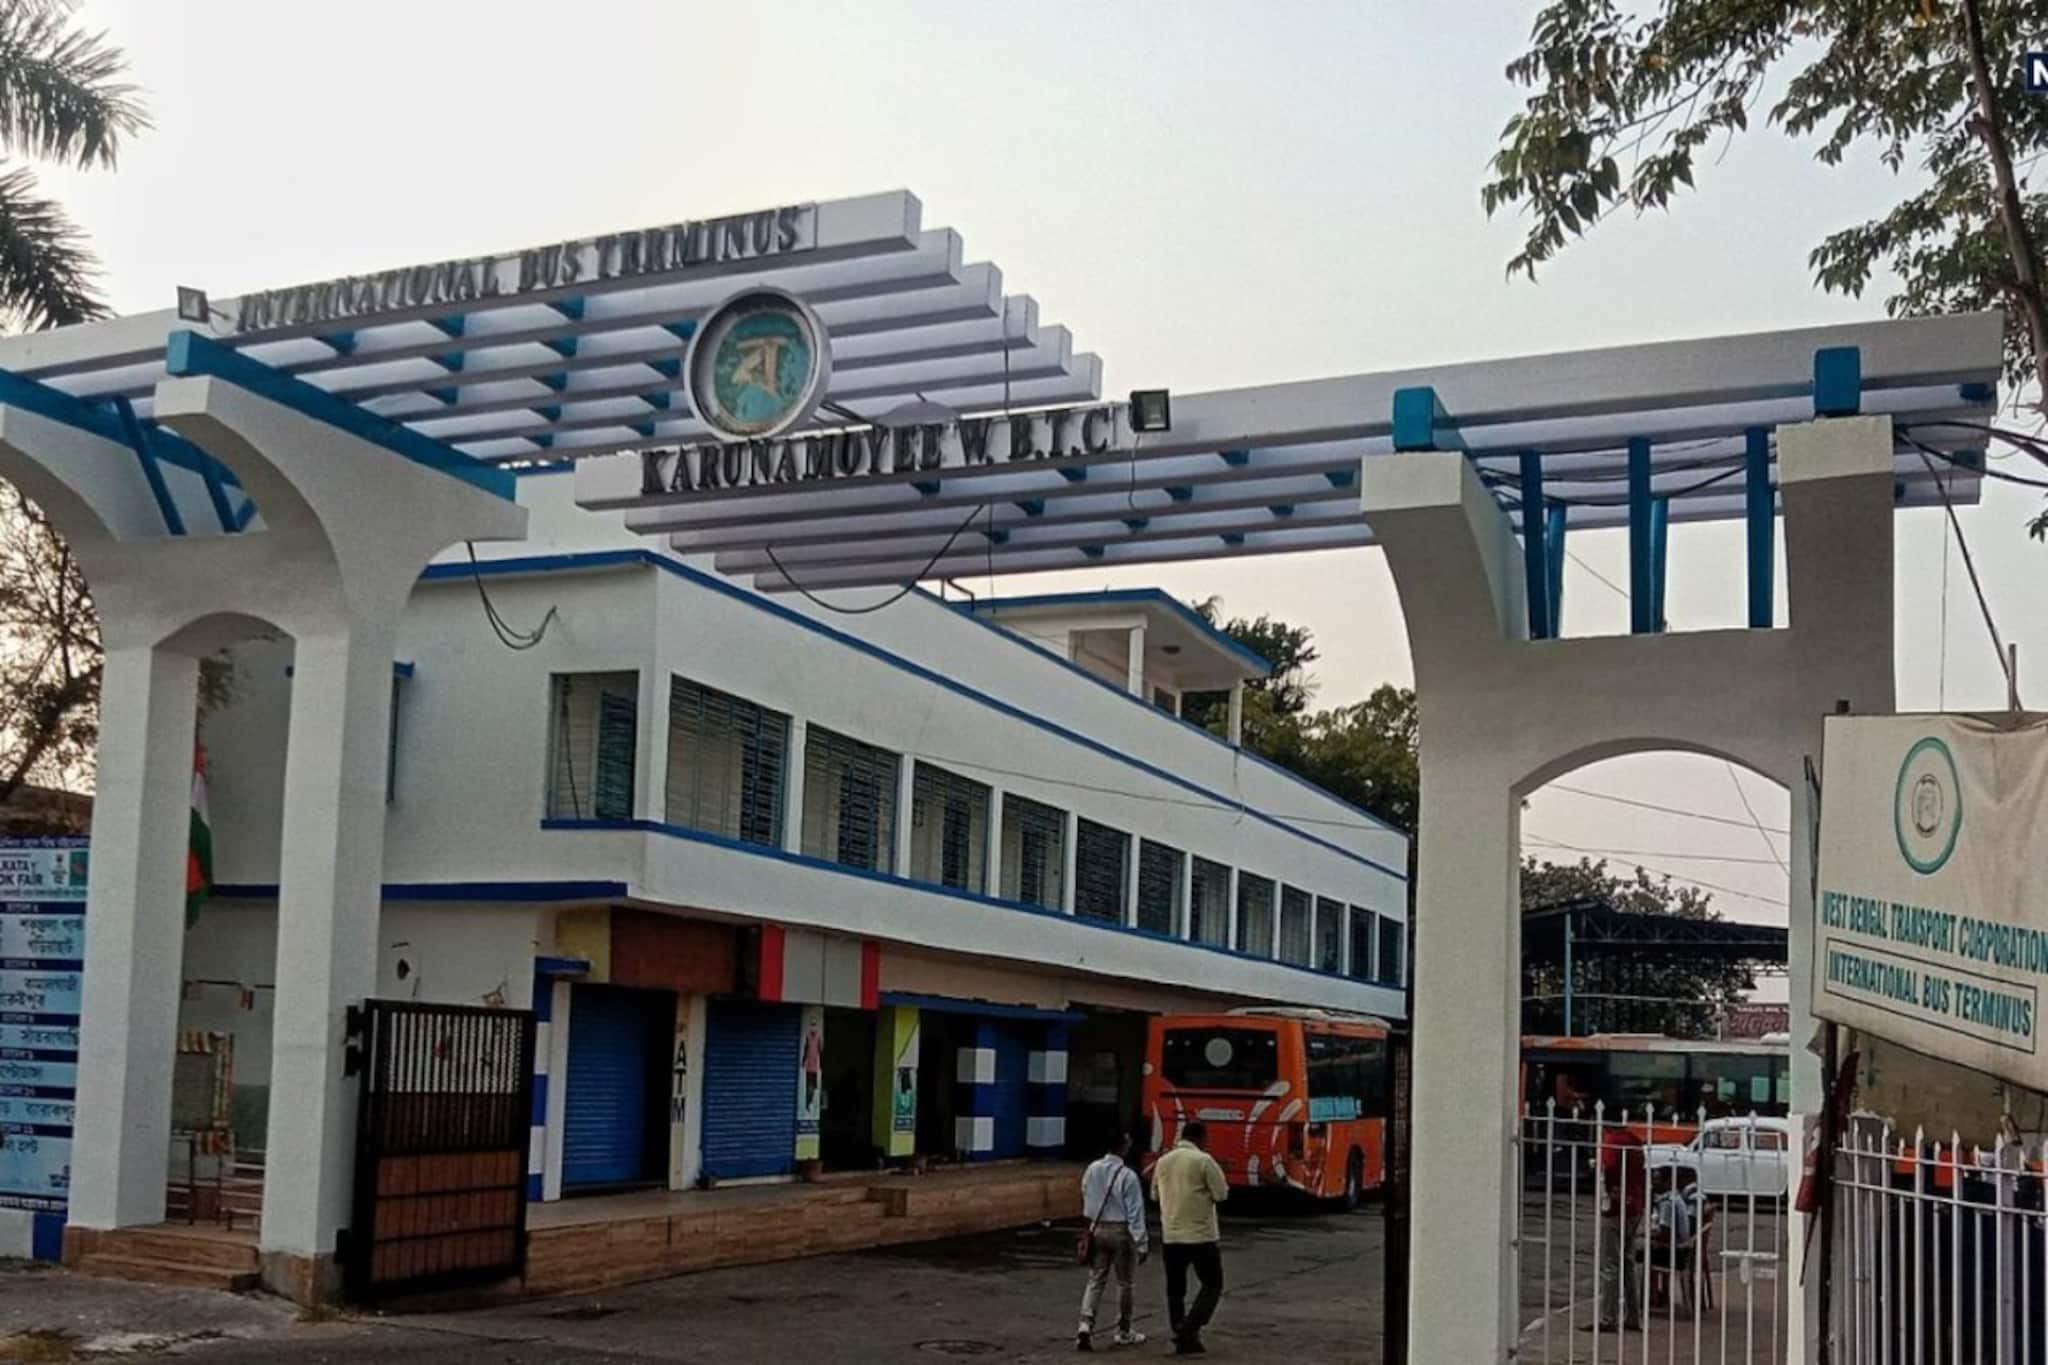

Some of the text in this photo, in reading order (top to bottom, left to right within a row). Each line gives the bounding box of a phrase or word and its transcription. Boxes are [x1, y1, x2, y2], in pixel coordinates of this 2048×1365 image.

[237, 206, 799, 334] INTERNATIONAL BUS TERMINUS
[641, 424, 943, 494] KARUNAMOYEE
[1822, 890, 1849, 929] WEST
[1850, 895, 1888, 938] BENGAL
[1891, 902, 1957, 953] TRANSPORT
[1828, 949, 2032, 1037] INTERNATIONAL BUS TERMINUS
[672, 1040, 687, 1123] ATM
